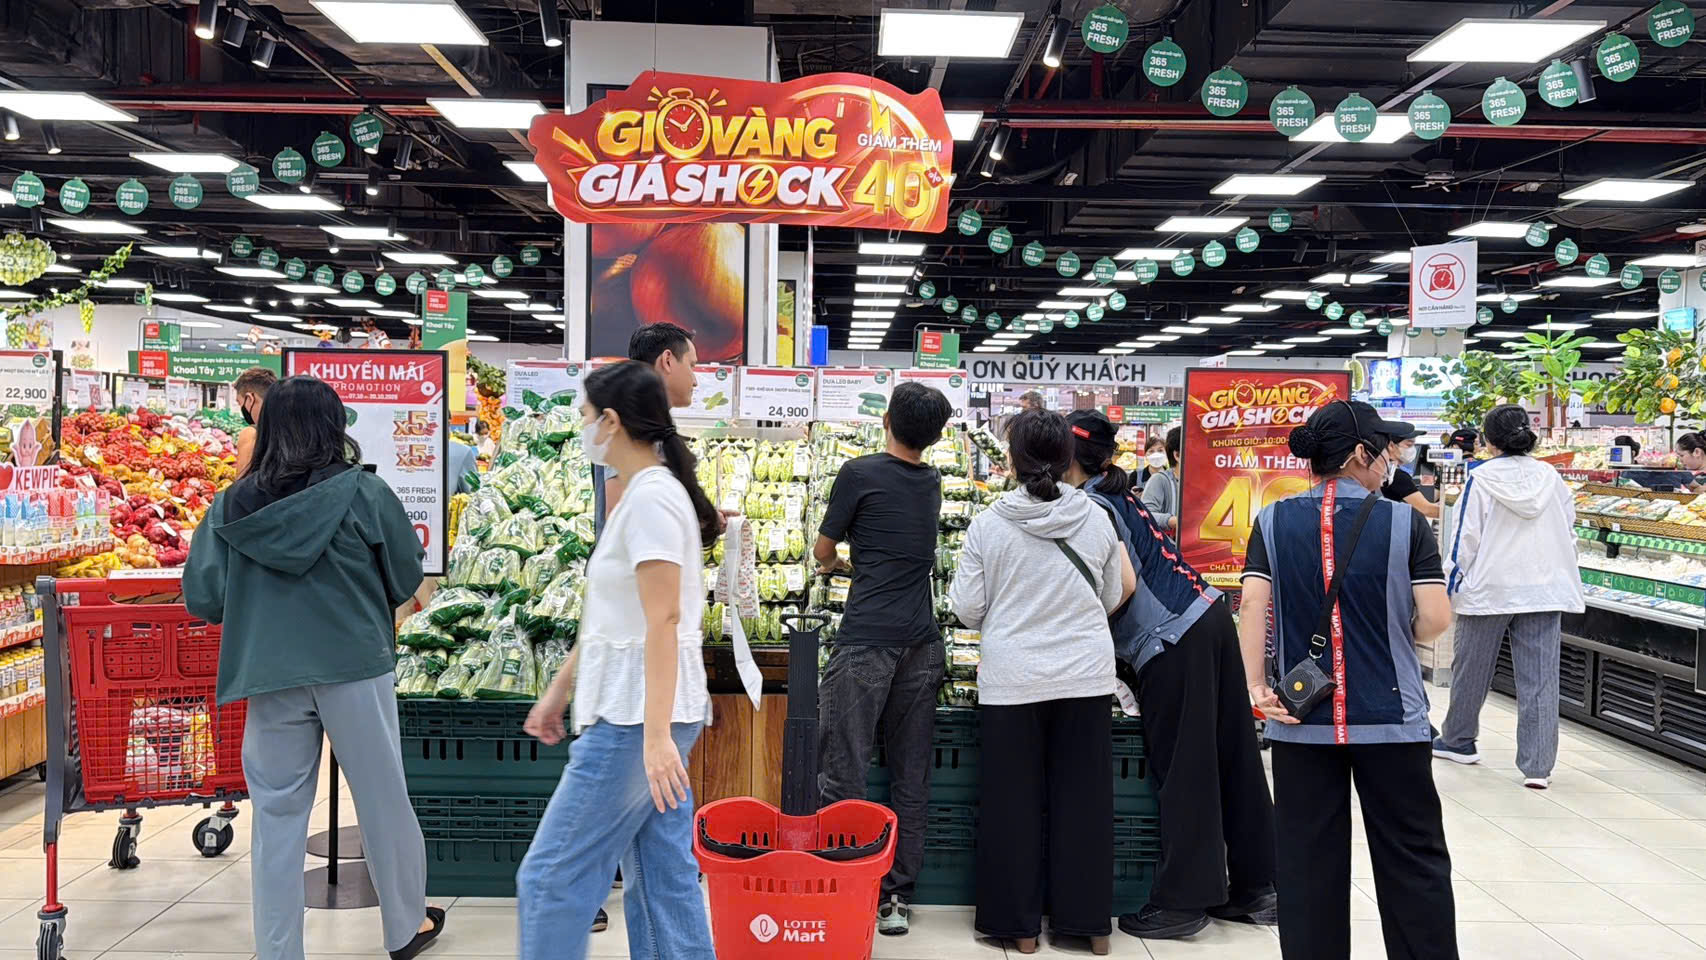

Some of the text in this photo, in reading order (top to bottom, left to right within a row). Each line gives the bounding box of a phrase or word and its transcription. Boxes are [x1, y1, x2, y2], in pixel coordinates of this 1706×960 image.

[1090, 21, 1108, 32] 365
[1654, 18, 1673, 30] 365
[1657, 25, 1690, 41] FRESH
[1086, 33, 1120, 47] FRESH
[1150, 56, 1167, 66] 365
[1603, 53, 1621, 65] 365
[1148, 68, 1179, 79] FRESH
[1607, 60, 1636, 76] FRESH
[1546, 79, 1564, 90] 365
[1208, 85, 1226, 96] 365
[1548, 88, 1577, 101] FRESH
[1207, 97, 1239, 109] FRESH
[1489, 98, 1506, 108] 365
[1276, 106, 1294, 116] 365
[1414, 112, 1430, 120] 365
[1490, 106, 1521, 119] FRESH
[1276, 118, 1308, 127] FRESH
[1340, 114, 1357, 123] 365
[1340, 124, 1371, 134] FRESH
[1414, 122, 1444, 131] FRESH
[357, 133, 380, 143] FRESH
[711, 107, 838, 159] VÀNG
[900, 135, 942, 152] THÊM
[318, 153, 341, 161] FRESH
[578, 155, 846, 206] GIÁ SHOCK
[16, 194, 39, 202] FRESH
[63, 199, 84, 208] FRESH
[199, 366, 214, 376] Tây
[310, 360, 425, 381] KHUYẾN MÃI
[973, 357, 1146, 382] ƠN QUÝ KHÁCH
[334, 383, 400, 391] PROMOTION
[6, 388, 47, 400] 22,900
[768, 406, 808, 418] 24,900
[1201, 405, 1238, 429] GIÁ
[1213, 437, 1242, 448] KHUNG
[16, 468, 59, 490] KEWPIE
[784, 920, 826, 928] LOTTE
[783, 929, 826, 942] Mart
